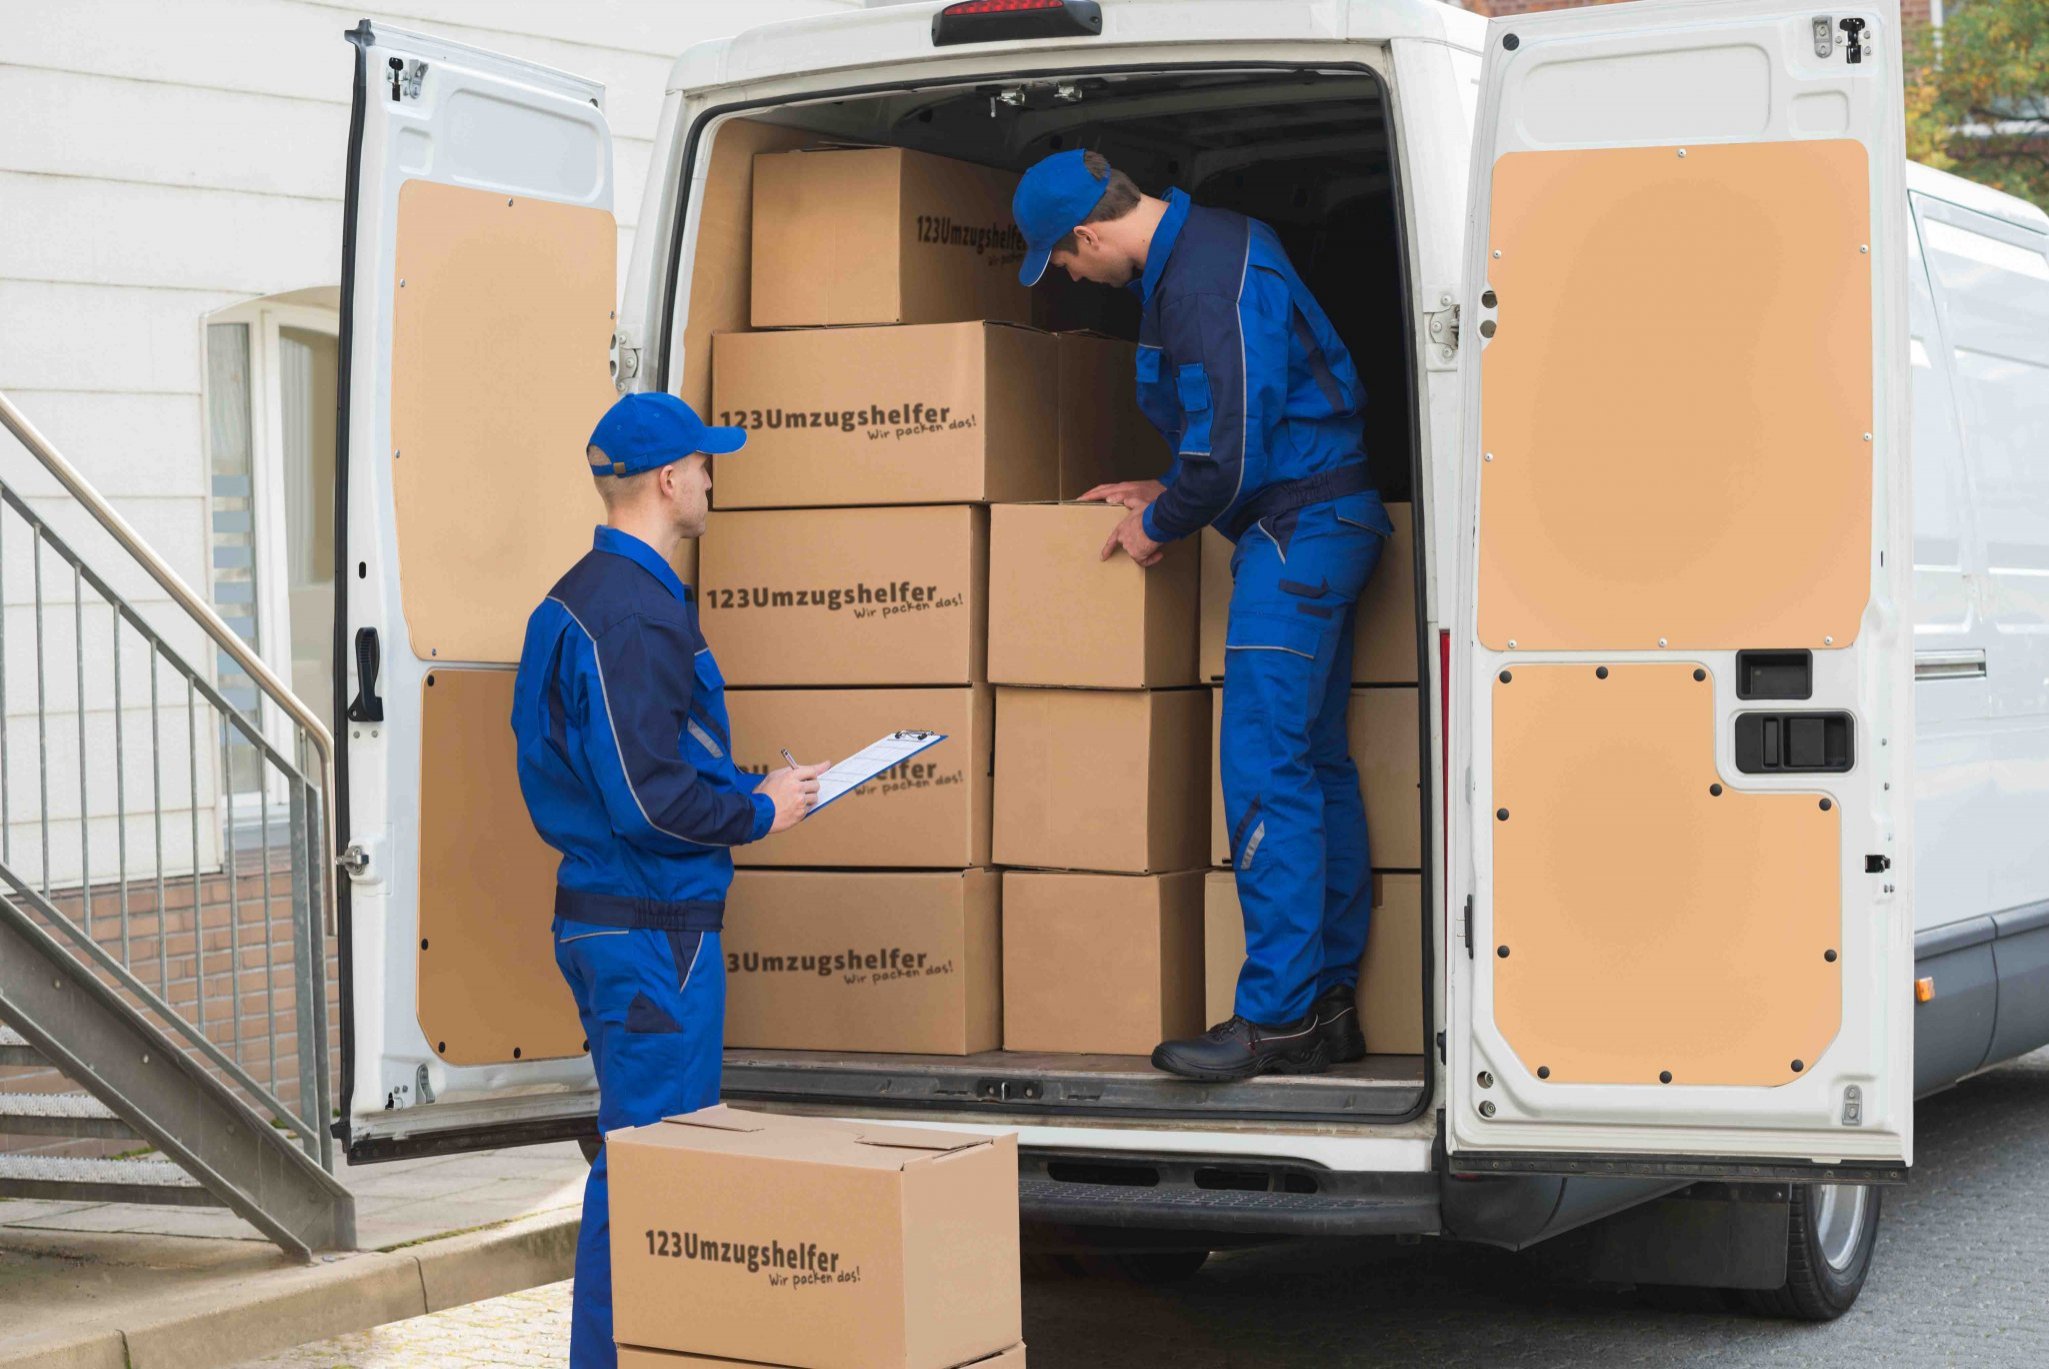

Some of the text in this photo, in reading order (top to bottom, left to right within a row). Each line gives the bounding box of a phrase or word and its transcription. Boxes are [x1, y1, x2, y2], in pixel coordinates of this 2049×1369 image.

[720, 403, 950, 432] 123Umzugshelfer
[868, 414, 977, 441] Wir packen das!
[707, 582, 937, 610] 123Umzugshelfer
[854, 593, 964, 619] Wir packen das!
[882, 777, 930, 796] packen
[935, 770, 964, 785] das!
[727, 948, 928, 976] 3Umzugshelfer
[844, 960, 954, 985] Wir packen das!
[645, 1229, 839, 1273] 123Umzugshelfer
[769, 1265, 861, 1290] Wir packen das!
